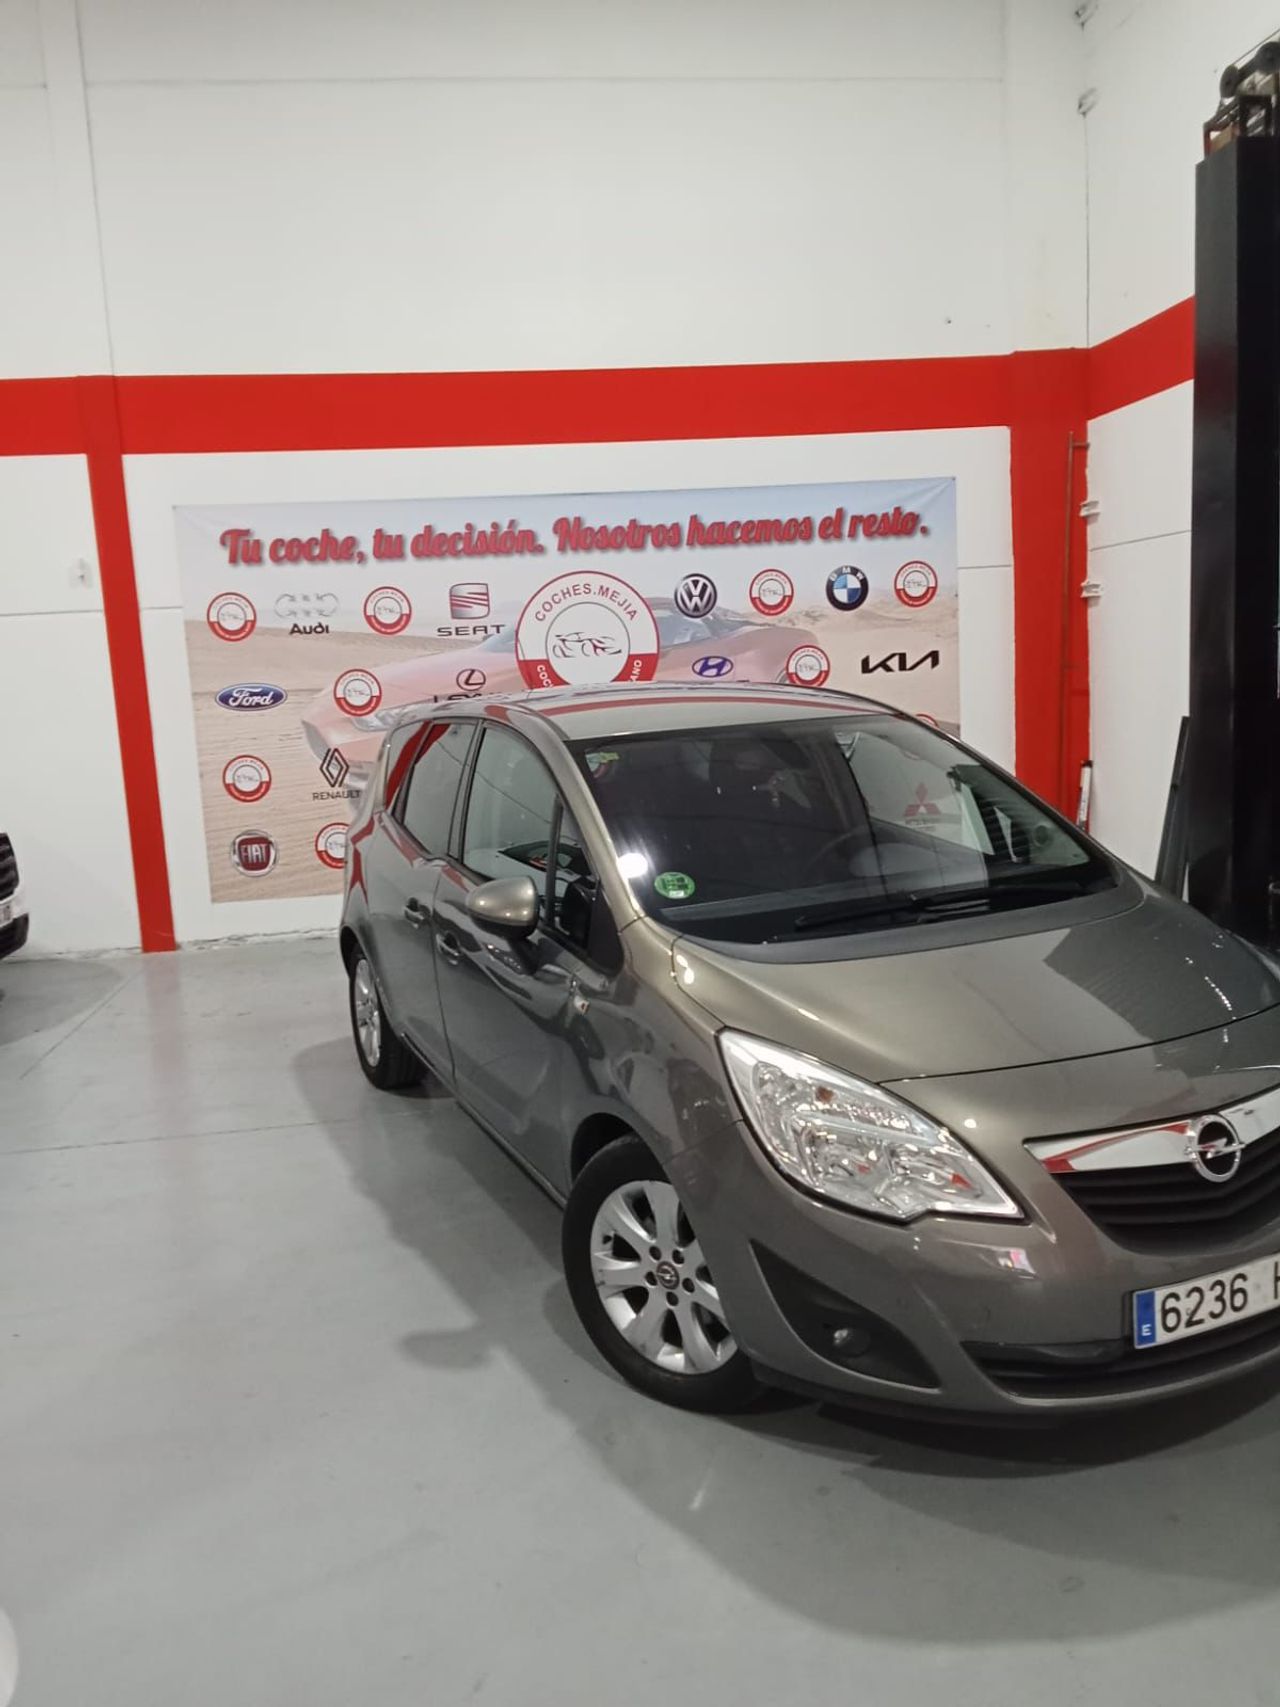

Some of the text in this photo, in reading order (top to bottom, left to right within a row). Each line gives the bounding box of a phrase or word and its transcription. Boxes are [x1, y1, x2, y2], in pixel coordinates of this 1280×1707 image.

[220, 506, 929, 565] Tu coche, tu decisión. Nosotros hacemos el resto.
[289, 621, 329, 635] Audi
[437, 624, 506, 637] SEAT
[861, 650, 939, 674] KIA
[228, 687, 274, 707] Ford
[312, 789, 360, 801] RENAULT
[240, 843, 268, 864] FIAT
[1141, 1323, 1152, 1337] E
[1161, 1273, 1248, 1333] 6236
